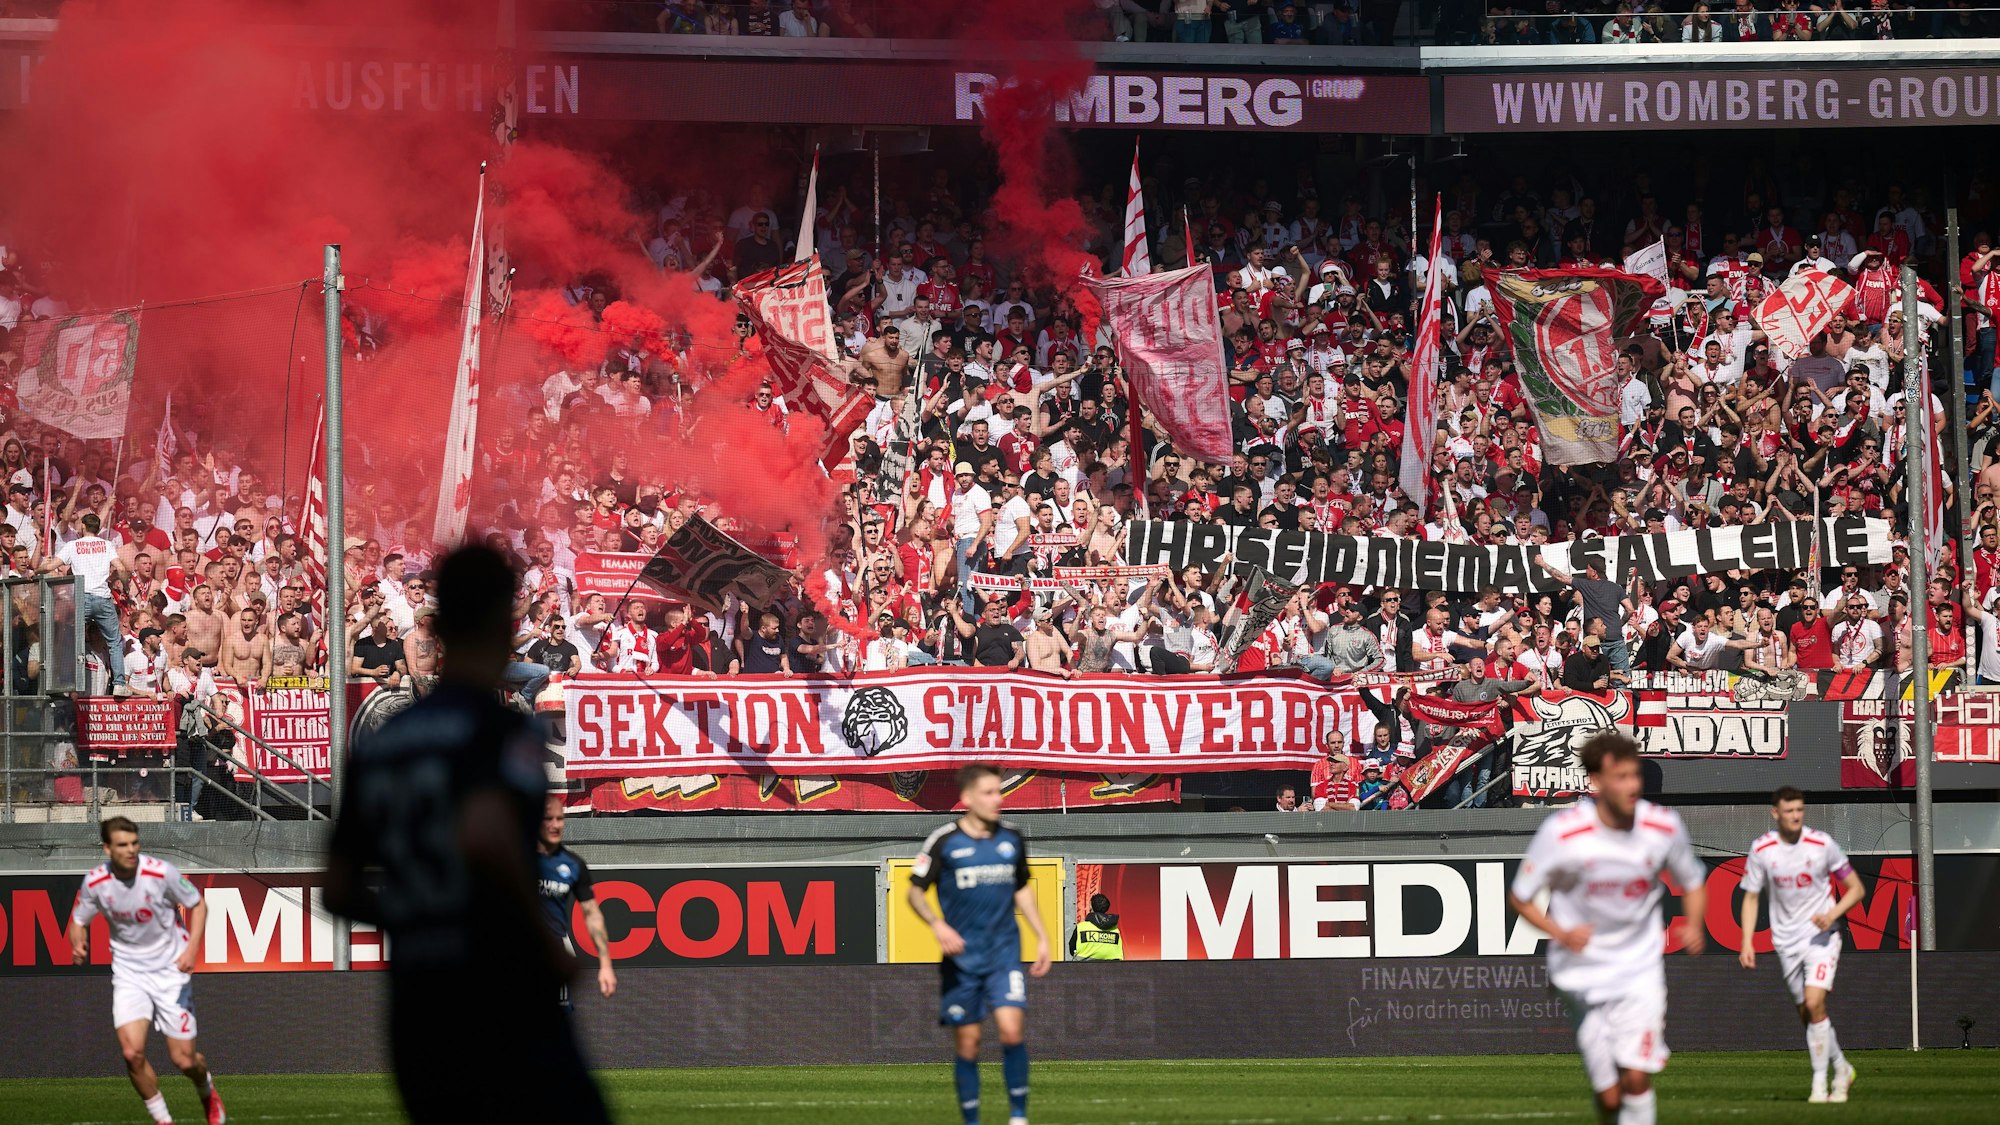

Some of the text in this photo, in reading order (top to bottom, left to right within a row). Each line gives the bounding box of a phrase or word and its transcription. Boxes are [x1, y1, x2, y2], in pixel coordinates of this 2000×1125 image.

[295, 60, 580, 115] AUSFÜHEN
[954, 72, 1366, 127] RMBERG GROUP
[1492, 75, 2000, 125] WWW.ROMBERG-GROU
[76, 546, 107, 555] CON NOI!
[1129, 515, 1869, 595] IHR SEID NIEMALS ALLEINE
[601, 558, 645, 570] JEMAND
[1058, 564, 1167, 578] WILDE HORDE
[612, 578, 630, 589] WELT
[79, 703, 171, 712] WEIL EHR SU SCHNELL
[105, 713, 139, 722] KAPOTT
[142, 712, 164, 721] JEHT
[577, 684, 1370, 758] SEKTION STADIONVERBOT
[85, 722, 166, 732] UND EHR BALD ALL
[261, 716, 329, 740] ULTRAS
[86, 733, 119, 742] WIDDER
[141, 732, 167, 741] STEHT
[1815, 963, 1826, 981] 6
[180, 1012, 191, 1033] 2
